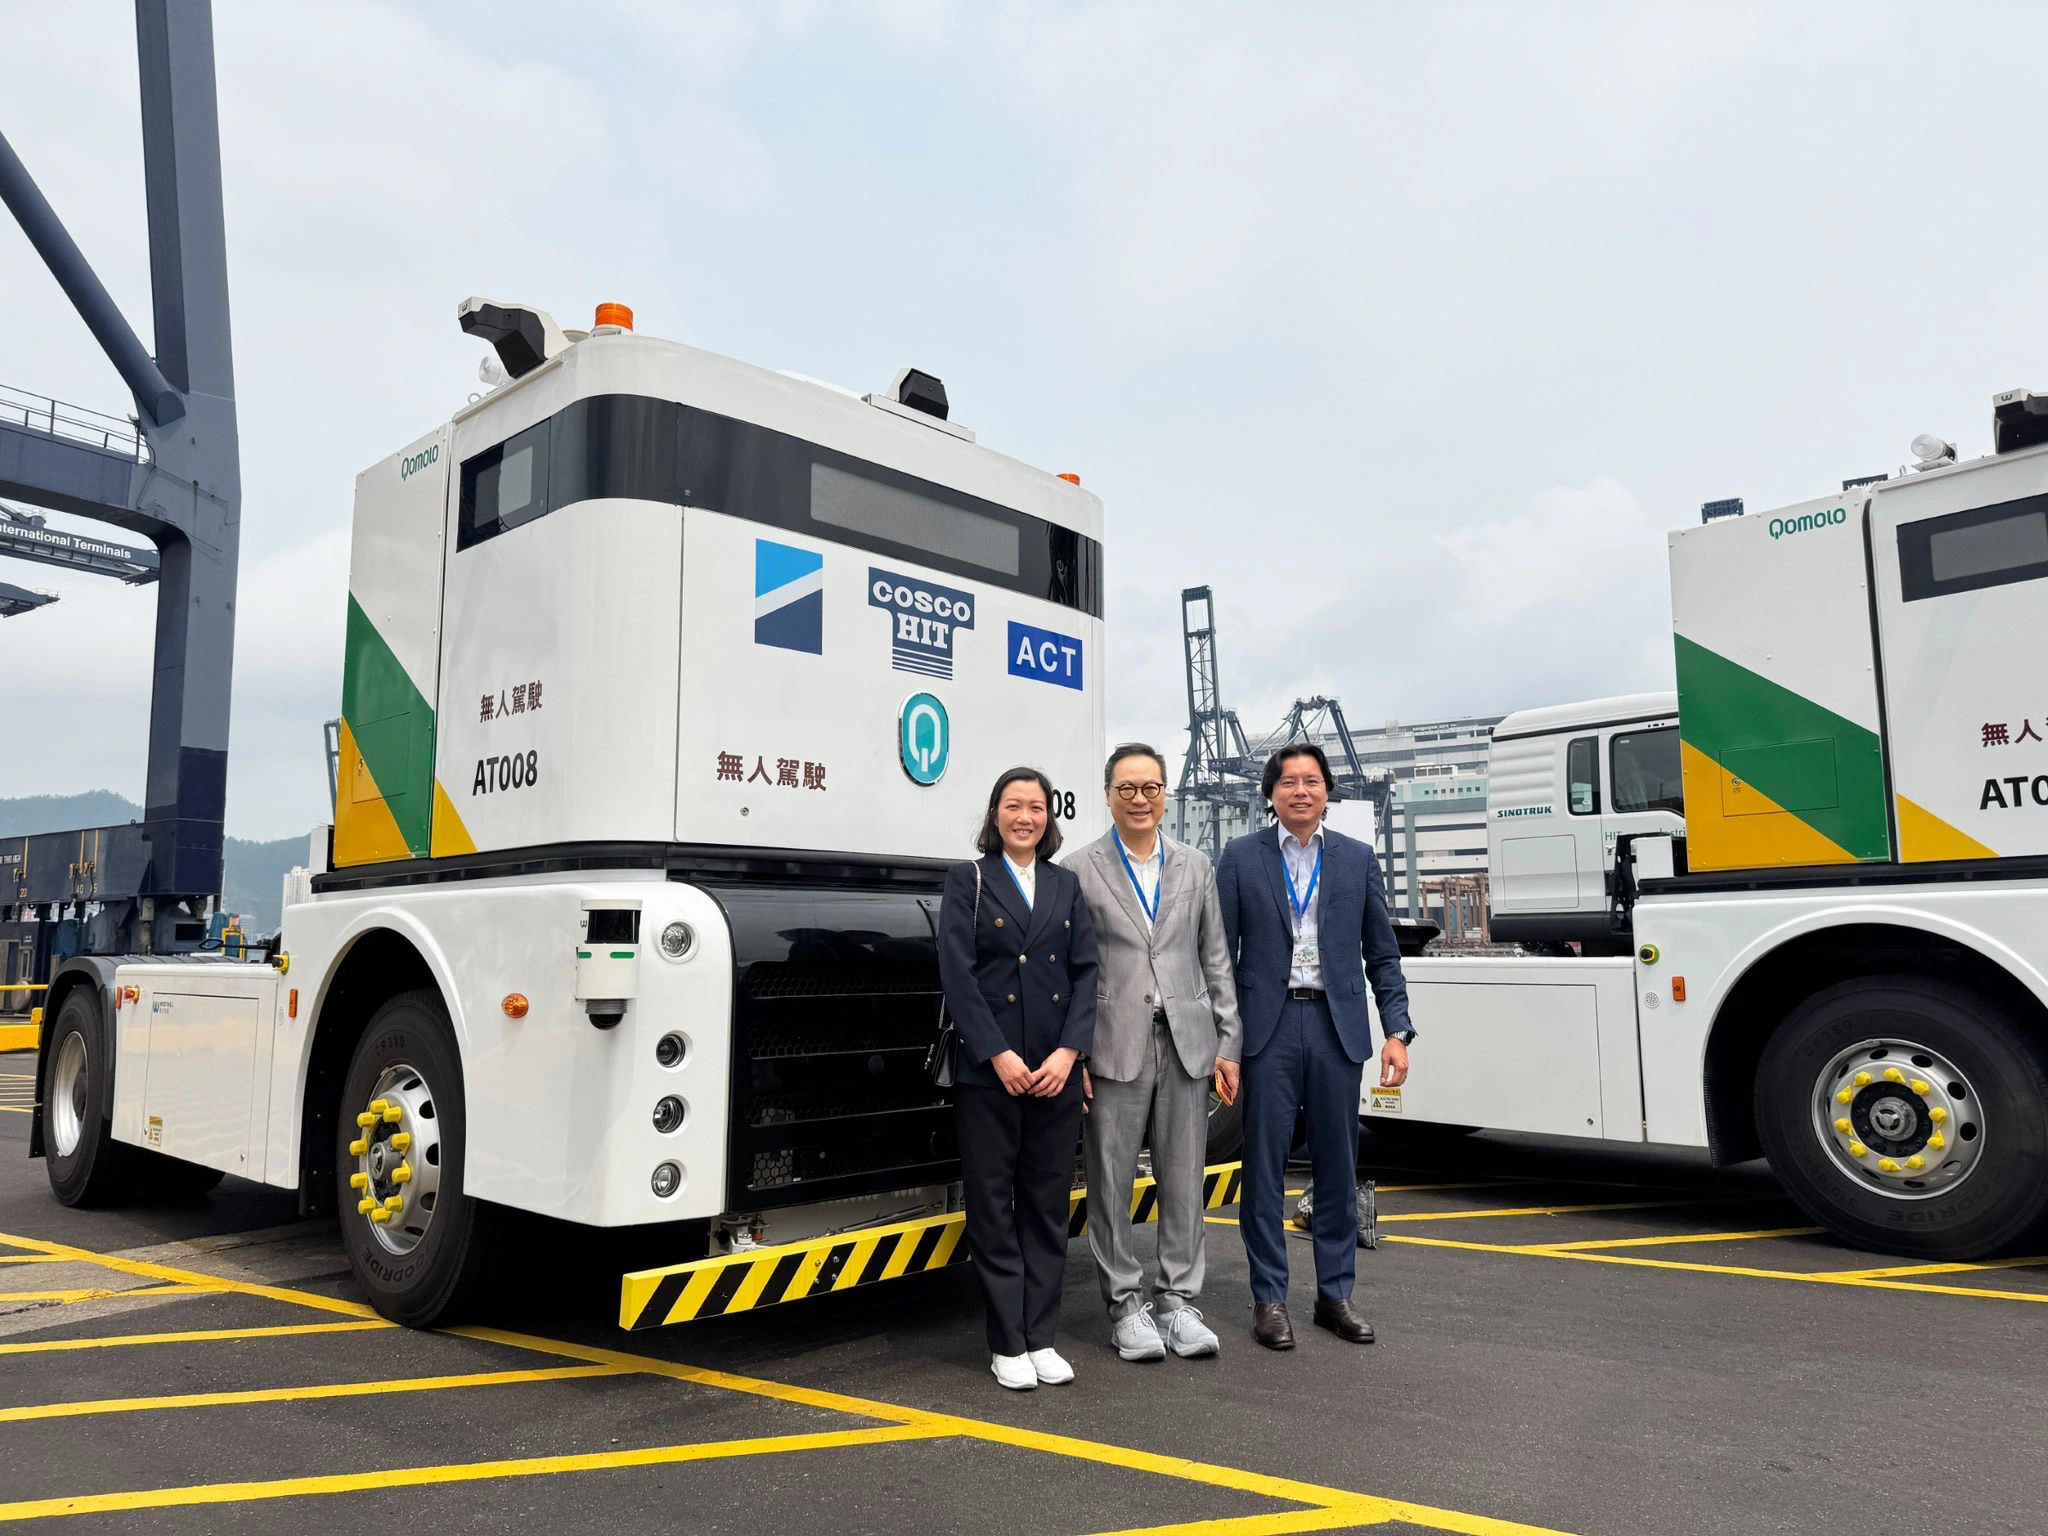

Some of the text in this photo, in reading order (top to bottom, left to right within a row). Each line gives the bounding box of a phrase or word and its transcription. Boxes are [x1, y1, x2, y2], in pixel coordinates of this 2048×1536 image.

[401, 444, 439, 482] Qomolo
[1769, 508, 1847, 540] Qomolo
[73, 537, 131, 559] Terminals
[872, 580, 971, 622] COSCO
[897, 612, 949, 650] HIT
[1016, 636, 1076, 677] ACT
[480, 680, 543, 723] 無人駕駛
[1981, 717, 2048, 748] 無人
[472, 749, 538, 796] AT008
[717, 750, 827, 792] 無人駕駛
[1497, 806, 1552, 818] SINOTRUK
